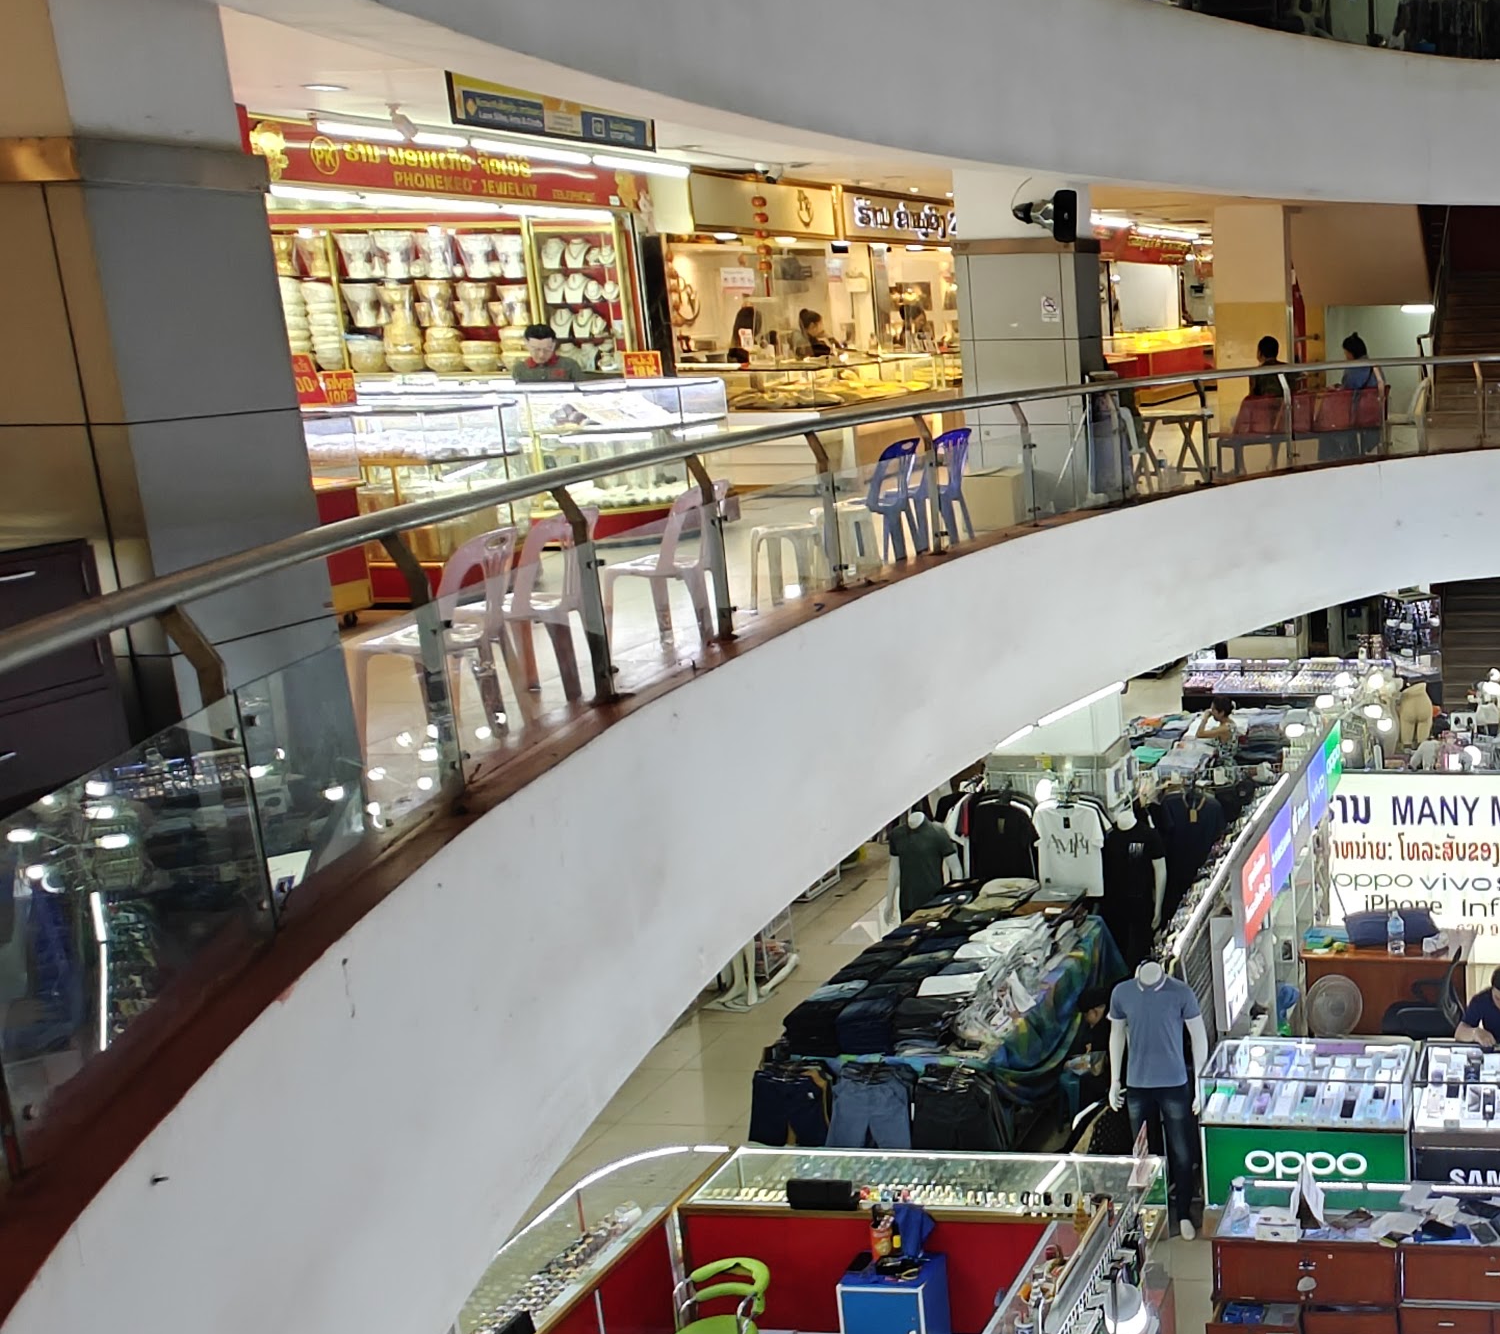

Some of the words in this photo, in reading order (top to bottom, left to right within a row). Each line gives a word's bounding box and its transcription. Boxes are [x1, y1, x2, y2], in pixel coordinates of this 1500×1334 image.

[1391, 795, 1480, 826] MANY
[1332, 872, 1413, 892] oppo
[1419, 873, 1492, 892] vivo
[1245, 1150, 1368, 1180] oppo
